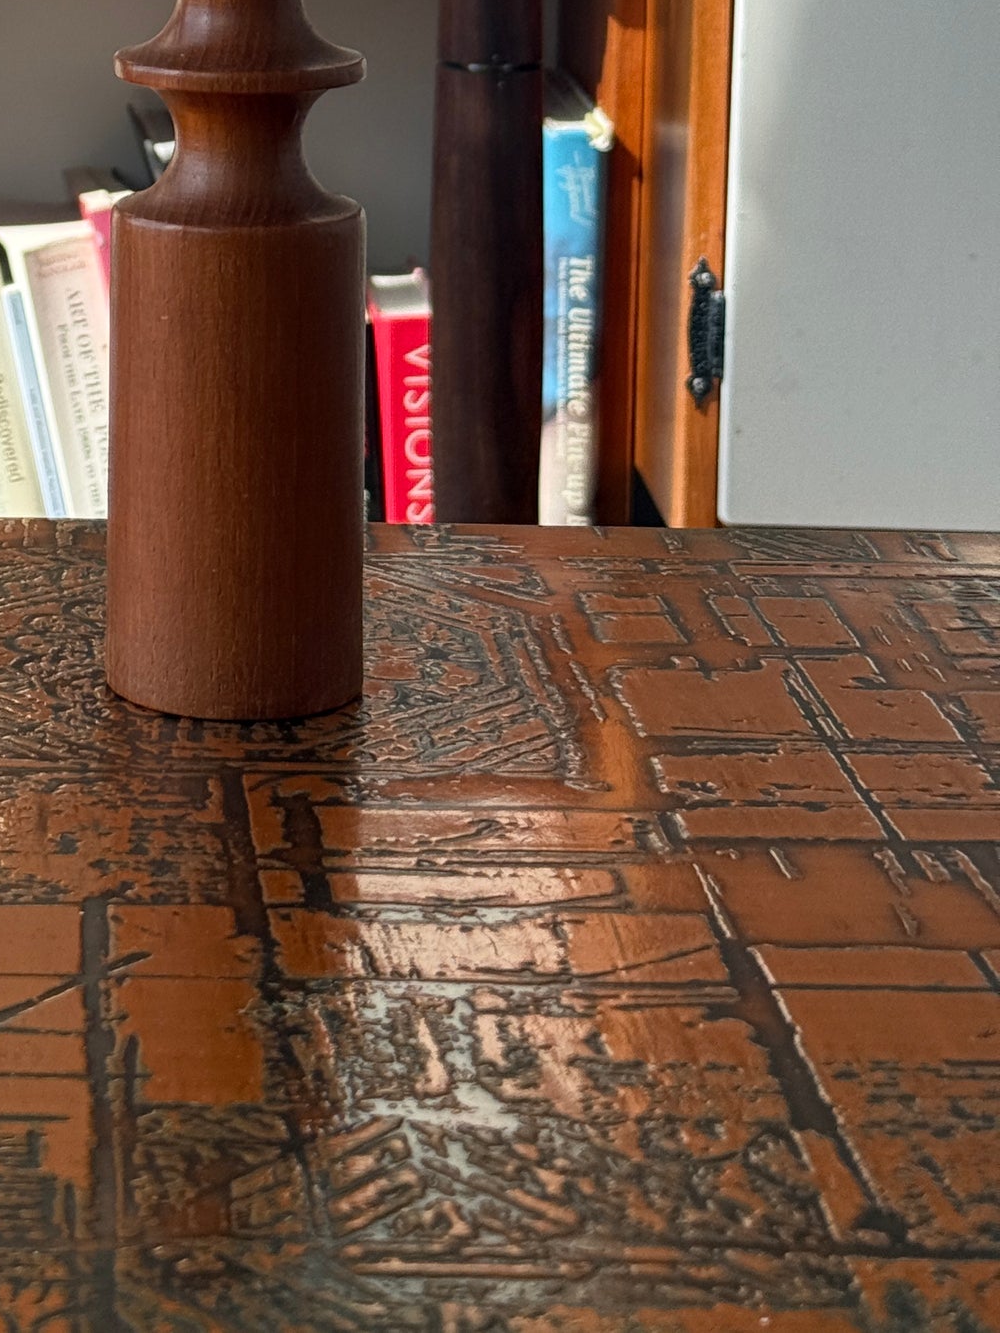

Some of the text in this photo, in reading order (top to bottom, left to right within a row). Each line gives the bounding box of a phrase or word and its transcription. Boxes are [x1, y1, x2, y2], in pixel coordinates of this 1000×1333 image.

[568, 255, 593, 300] The
[66, 290, 104, 414] ART OF THE
[568, 307, 592, 416] Ultimate
[403, 344, 434, 523] VISIONS
[562, 421, 590, 507] Pin-up
